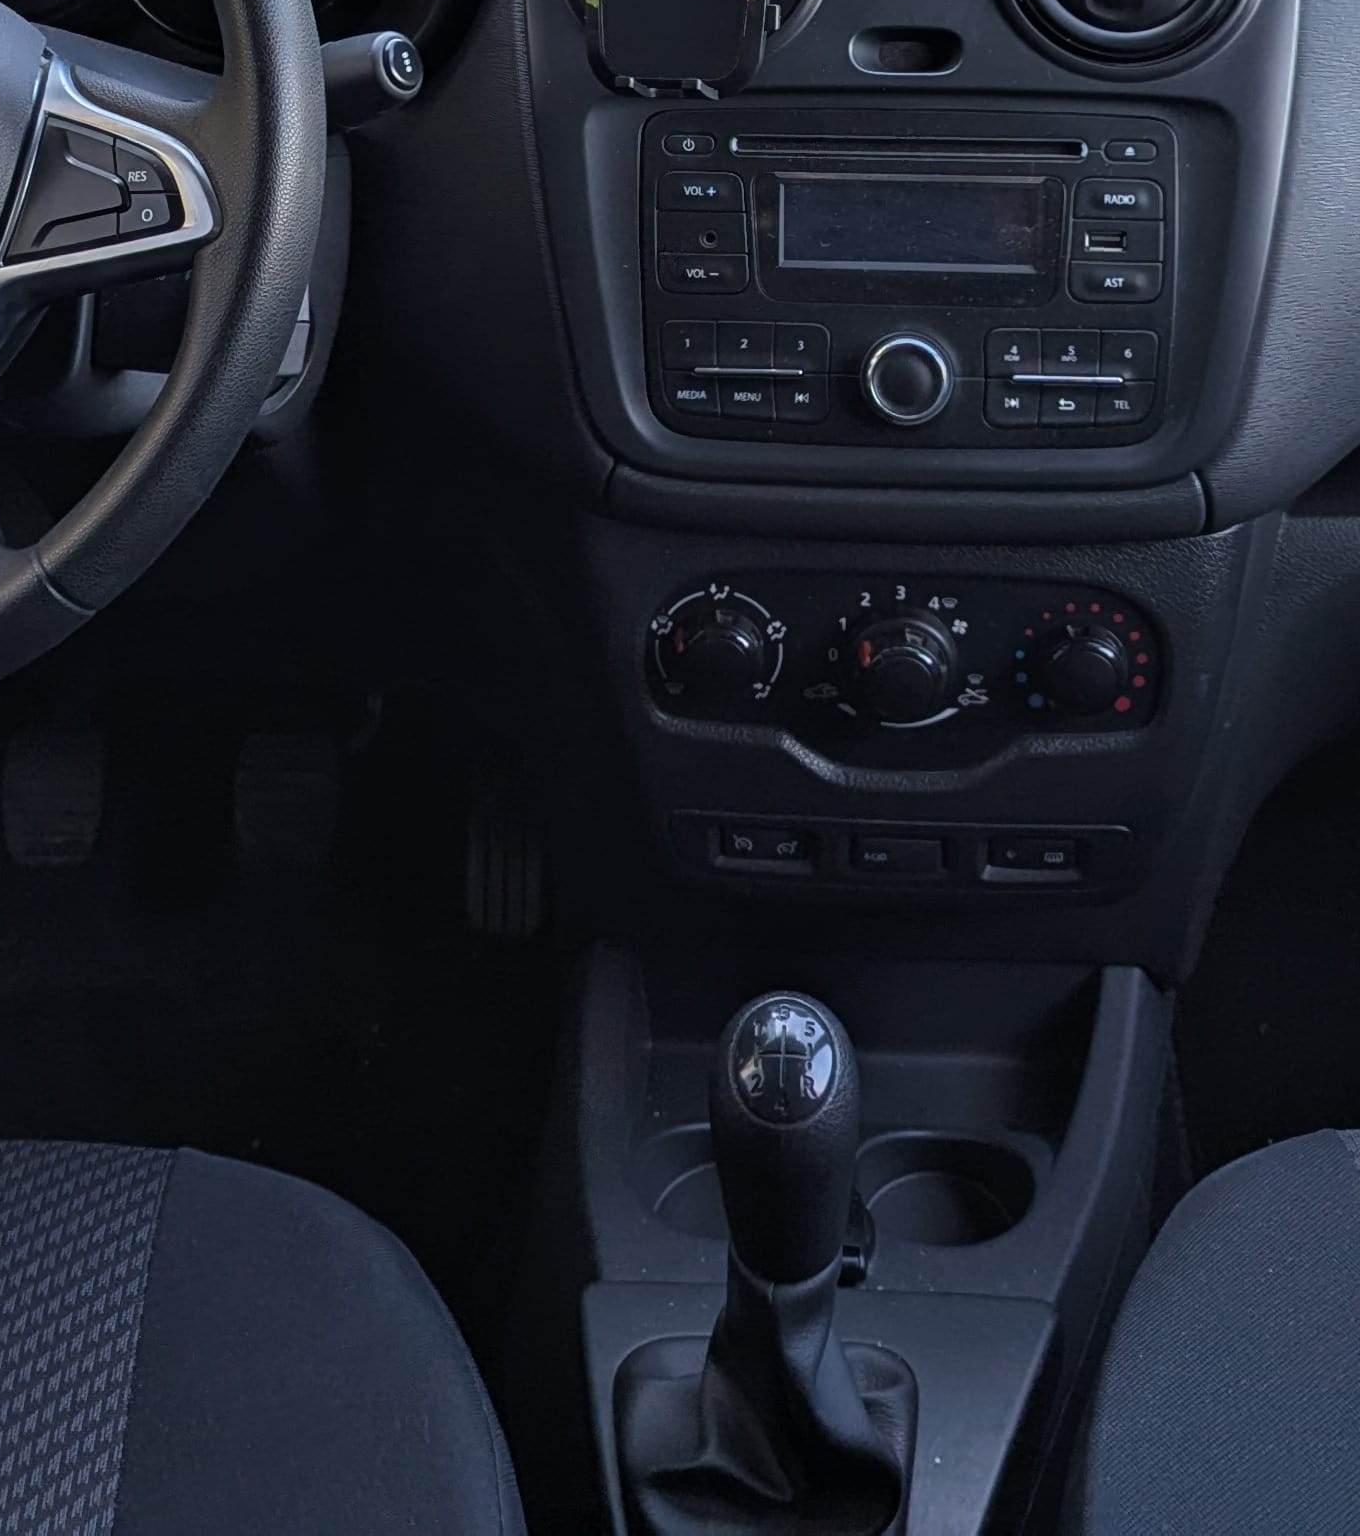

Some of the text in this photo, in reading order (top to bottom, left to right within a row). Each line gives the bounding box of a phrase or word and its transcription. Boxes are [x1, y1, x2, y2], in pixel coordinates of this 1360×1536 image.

[127, 170, 148, 183] RES
[683, 185, 705, 196] VOL
[1103, 193, 1136, 205] RADIO
[686, 268, 707, 279] VOL
[1103, 277, 1125, 288] AST
[684, 338, 691, 348] 1
[740, 338, 749, 349] 2
[797, 340, 805, 351] 3
[1009, 345, 1019, 355] 4
[1067, 345, 1077, 355] 5
[1123, 348, 1133, 359] 6
[676, 389, 707, 400] MEDIA
[733, 391, 762, 402] MENU
[1113, 399, 1131, 410] TEL
[895, 584, 906, 600] 3
[860, 591, 872, 607] 2
[927, 595, 940, 611] 4
[838, 616, 848, 632] 1
[803, 1020, 817, 1037] 5
[801, 1074, 818, 1100] R
